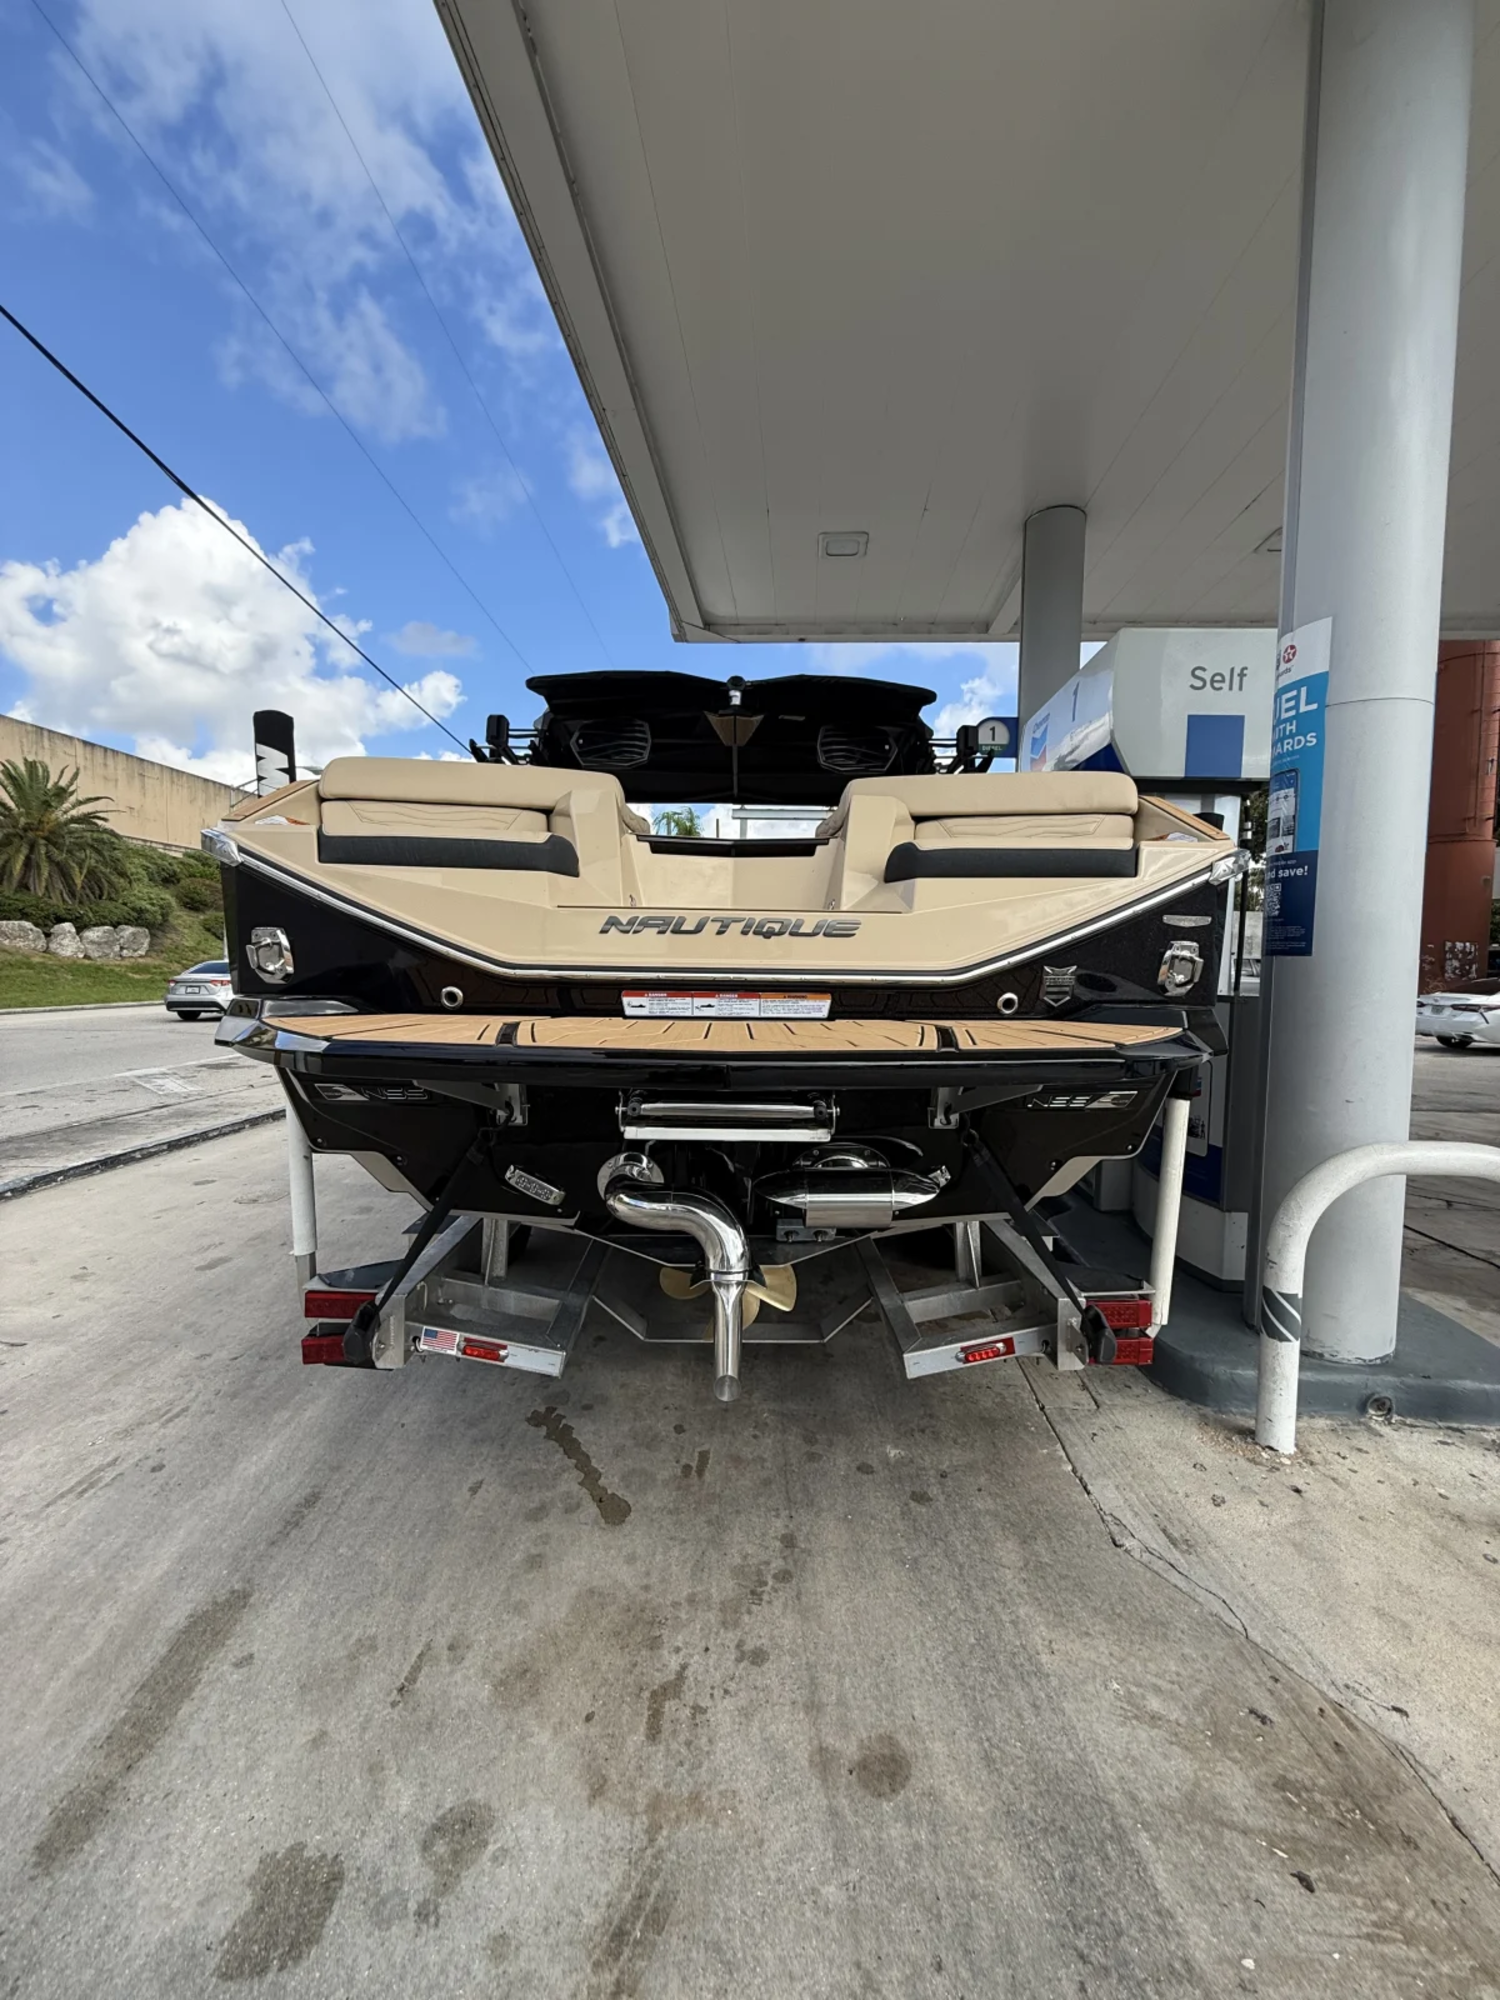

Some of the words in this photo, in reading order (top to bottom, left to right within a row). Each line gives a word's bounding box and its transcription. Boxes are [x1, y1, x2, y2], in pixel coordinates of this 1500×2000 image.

[1189, 665, 1249, 692] Self
[1072, 680, 1080, 722] 1
[989, 725, 996, 742] 1
[1273, 719, 1296, 740] ITH
[1272, 731, 1317, 757] ARDS
[1278, 865, 1309, 878] save!
[598, 915, 862, 940] NAUTIQUE
